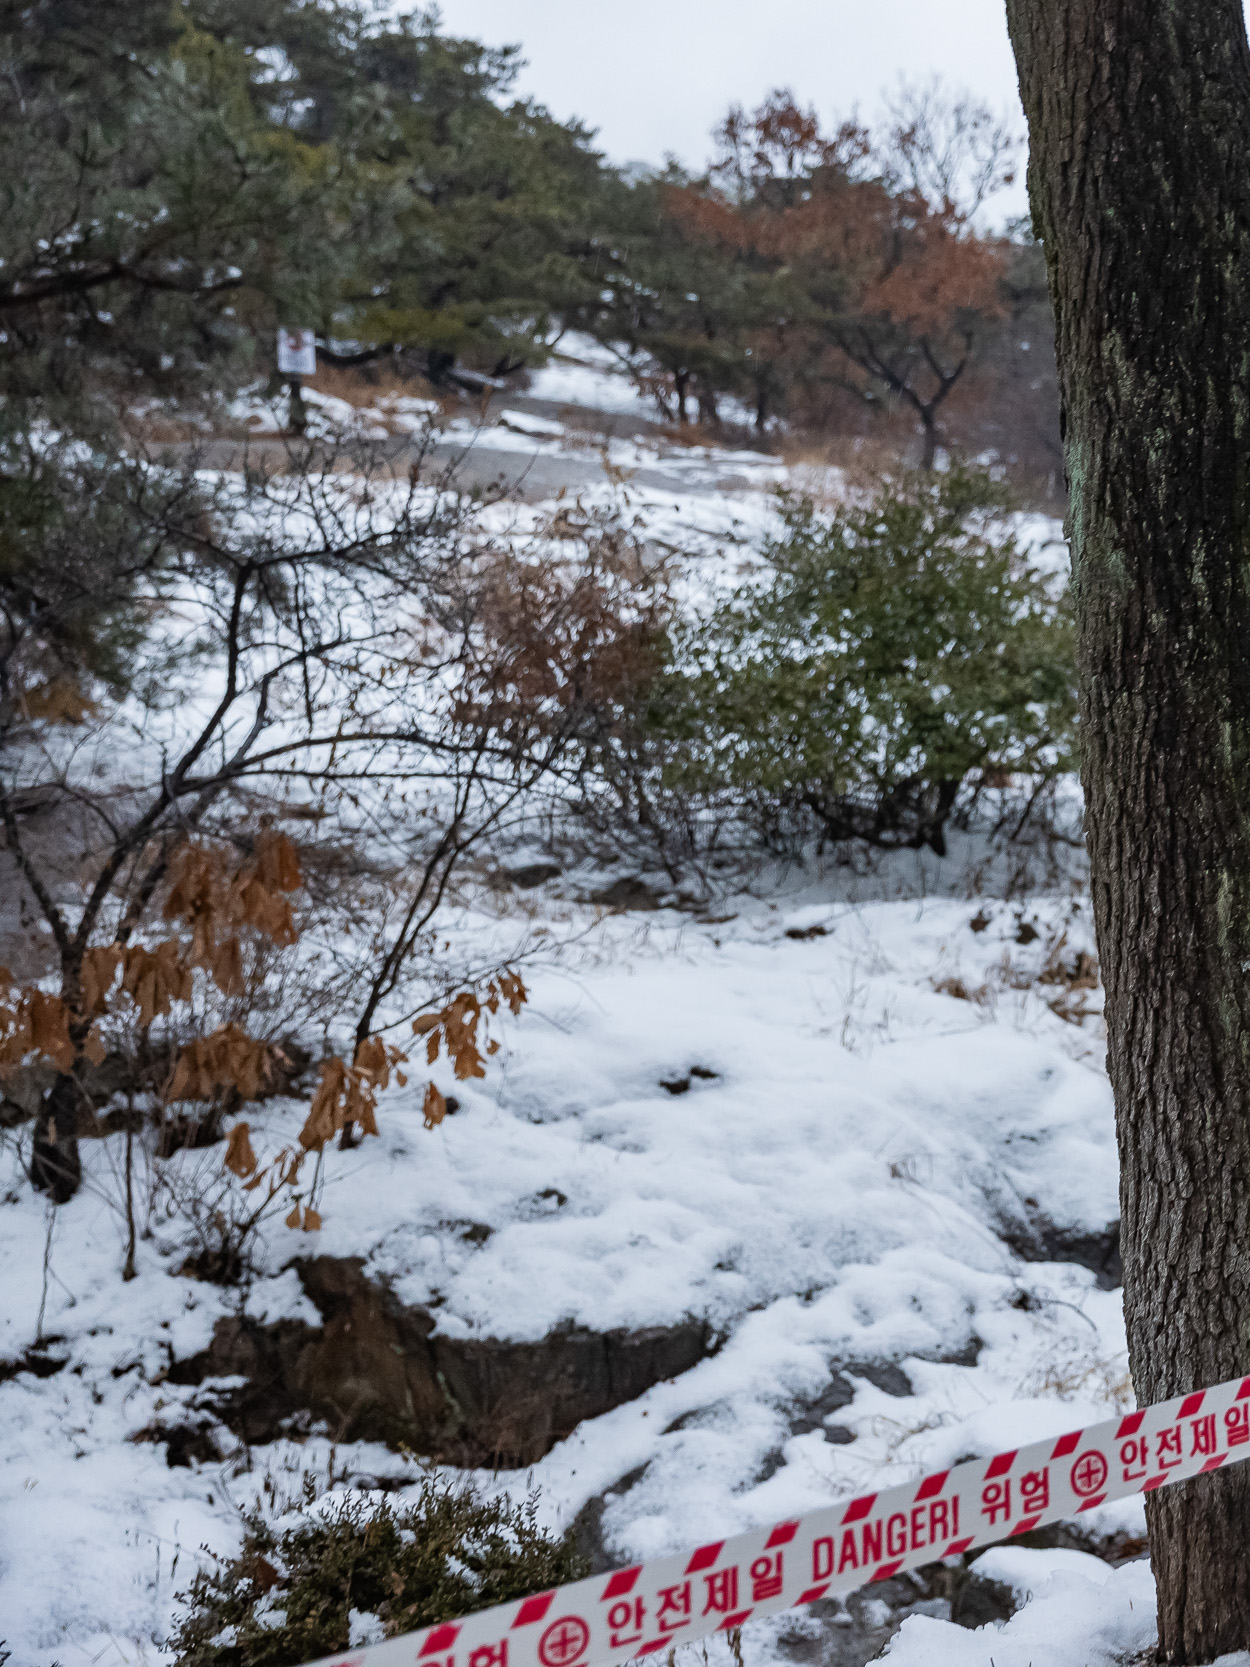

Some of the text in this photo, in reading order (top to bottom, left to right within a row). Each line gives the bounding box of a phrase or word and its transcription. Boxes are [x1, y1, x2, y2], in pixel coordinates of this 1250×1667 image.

[607, 1551, 784, 1649] 안전제일
[980, 1466, 1050, 1526] 위험
[1119, 1402, 1250, 1482] 안전제일
